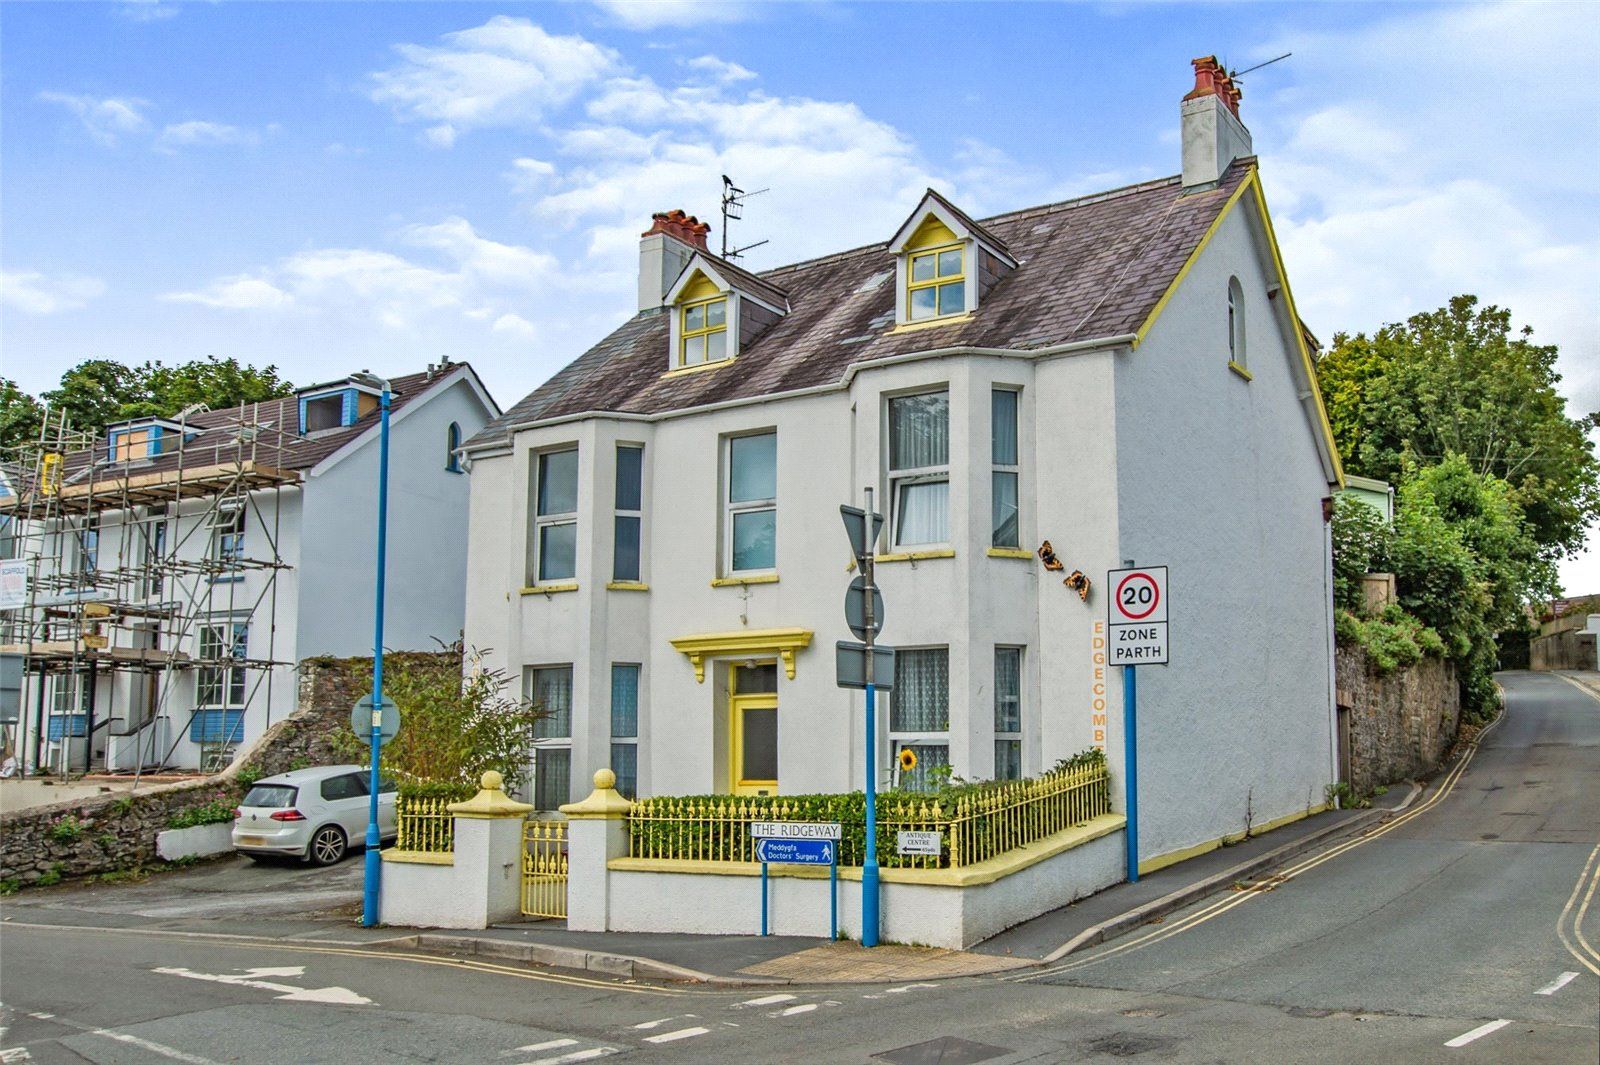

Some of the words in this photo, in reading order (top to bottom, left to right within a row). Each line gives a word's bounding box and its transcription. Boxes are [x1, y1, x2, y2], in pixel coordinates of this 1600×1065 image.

[1123, 586, 1152, 605] 20
[1119, 628, 1157, 641] ZONE
[1117, 646, 1161, 659] PARTH
[755, 824, 775, 835] THE
[781, 825, 838, 837] RIDGEWAY
[768, 844, 797, 852] Meddygfa
[795, 853, 819, 861] Surgery
